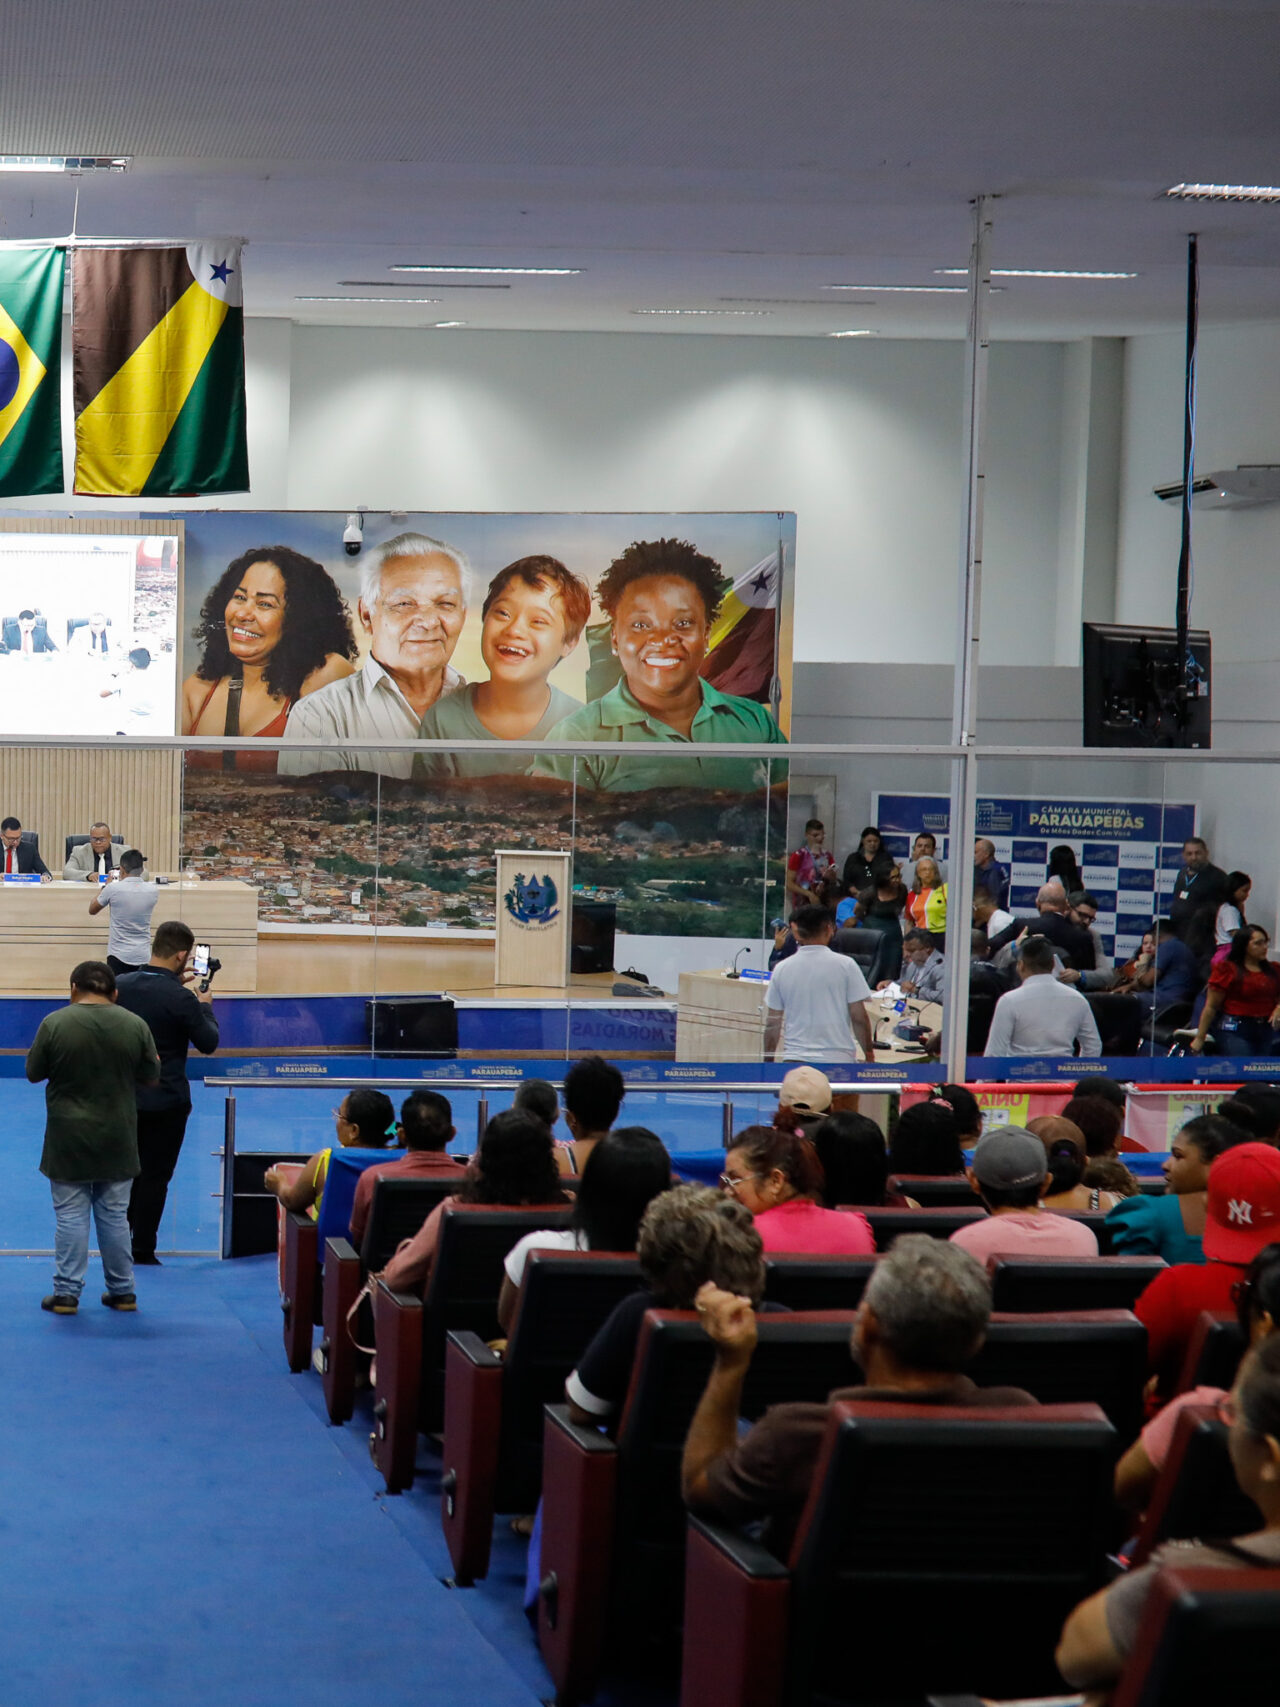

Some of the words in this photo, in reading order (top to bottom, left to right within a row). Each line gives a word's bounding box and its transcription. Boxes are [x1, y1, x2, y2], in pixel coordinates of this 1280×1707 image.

[1041, 805, 1080, 815] CÂMARA
[1082, 807, 1132, 817] MUNICIPAL
[1029, 813, 1145, 829] PARAUAPEBAS
